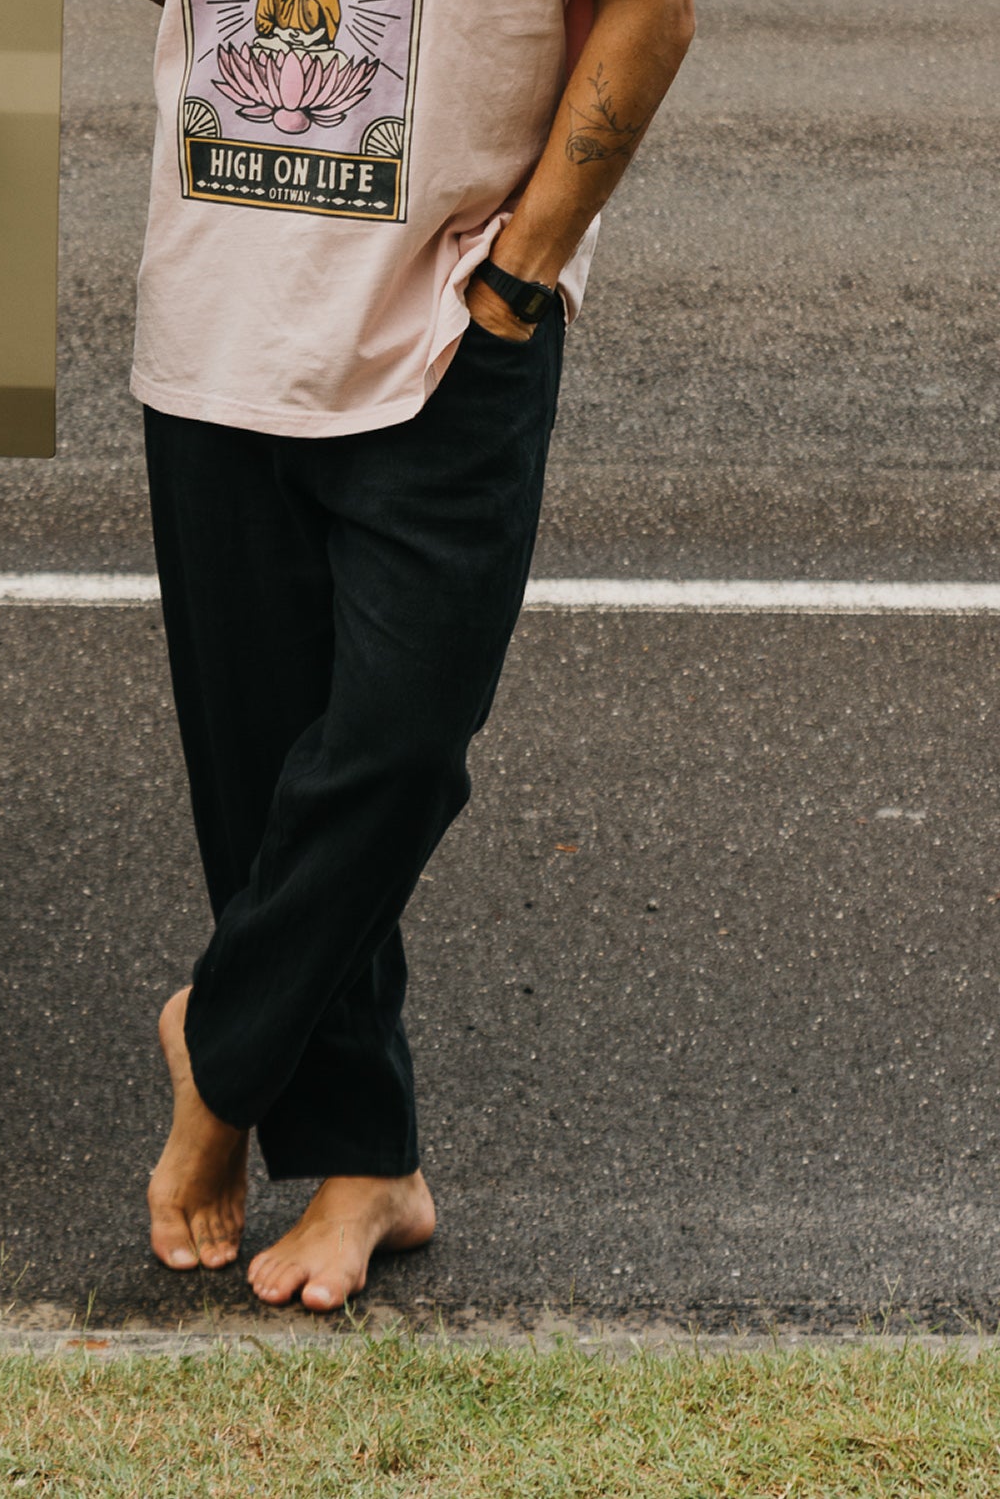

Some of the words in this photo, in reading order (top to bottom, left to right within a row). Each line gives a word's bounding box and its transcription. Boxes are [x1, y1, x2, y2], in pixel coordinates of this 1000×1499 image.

[210, 148, 263, 181] HIGH
[274, 155, 310, 186] ON
[316, 159, 374, 193] LIFE
[269, 187, 311, 203] OTTWAY
